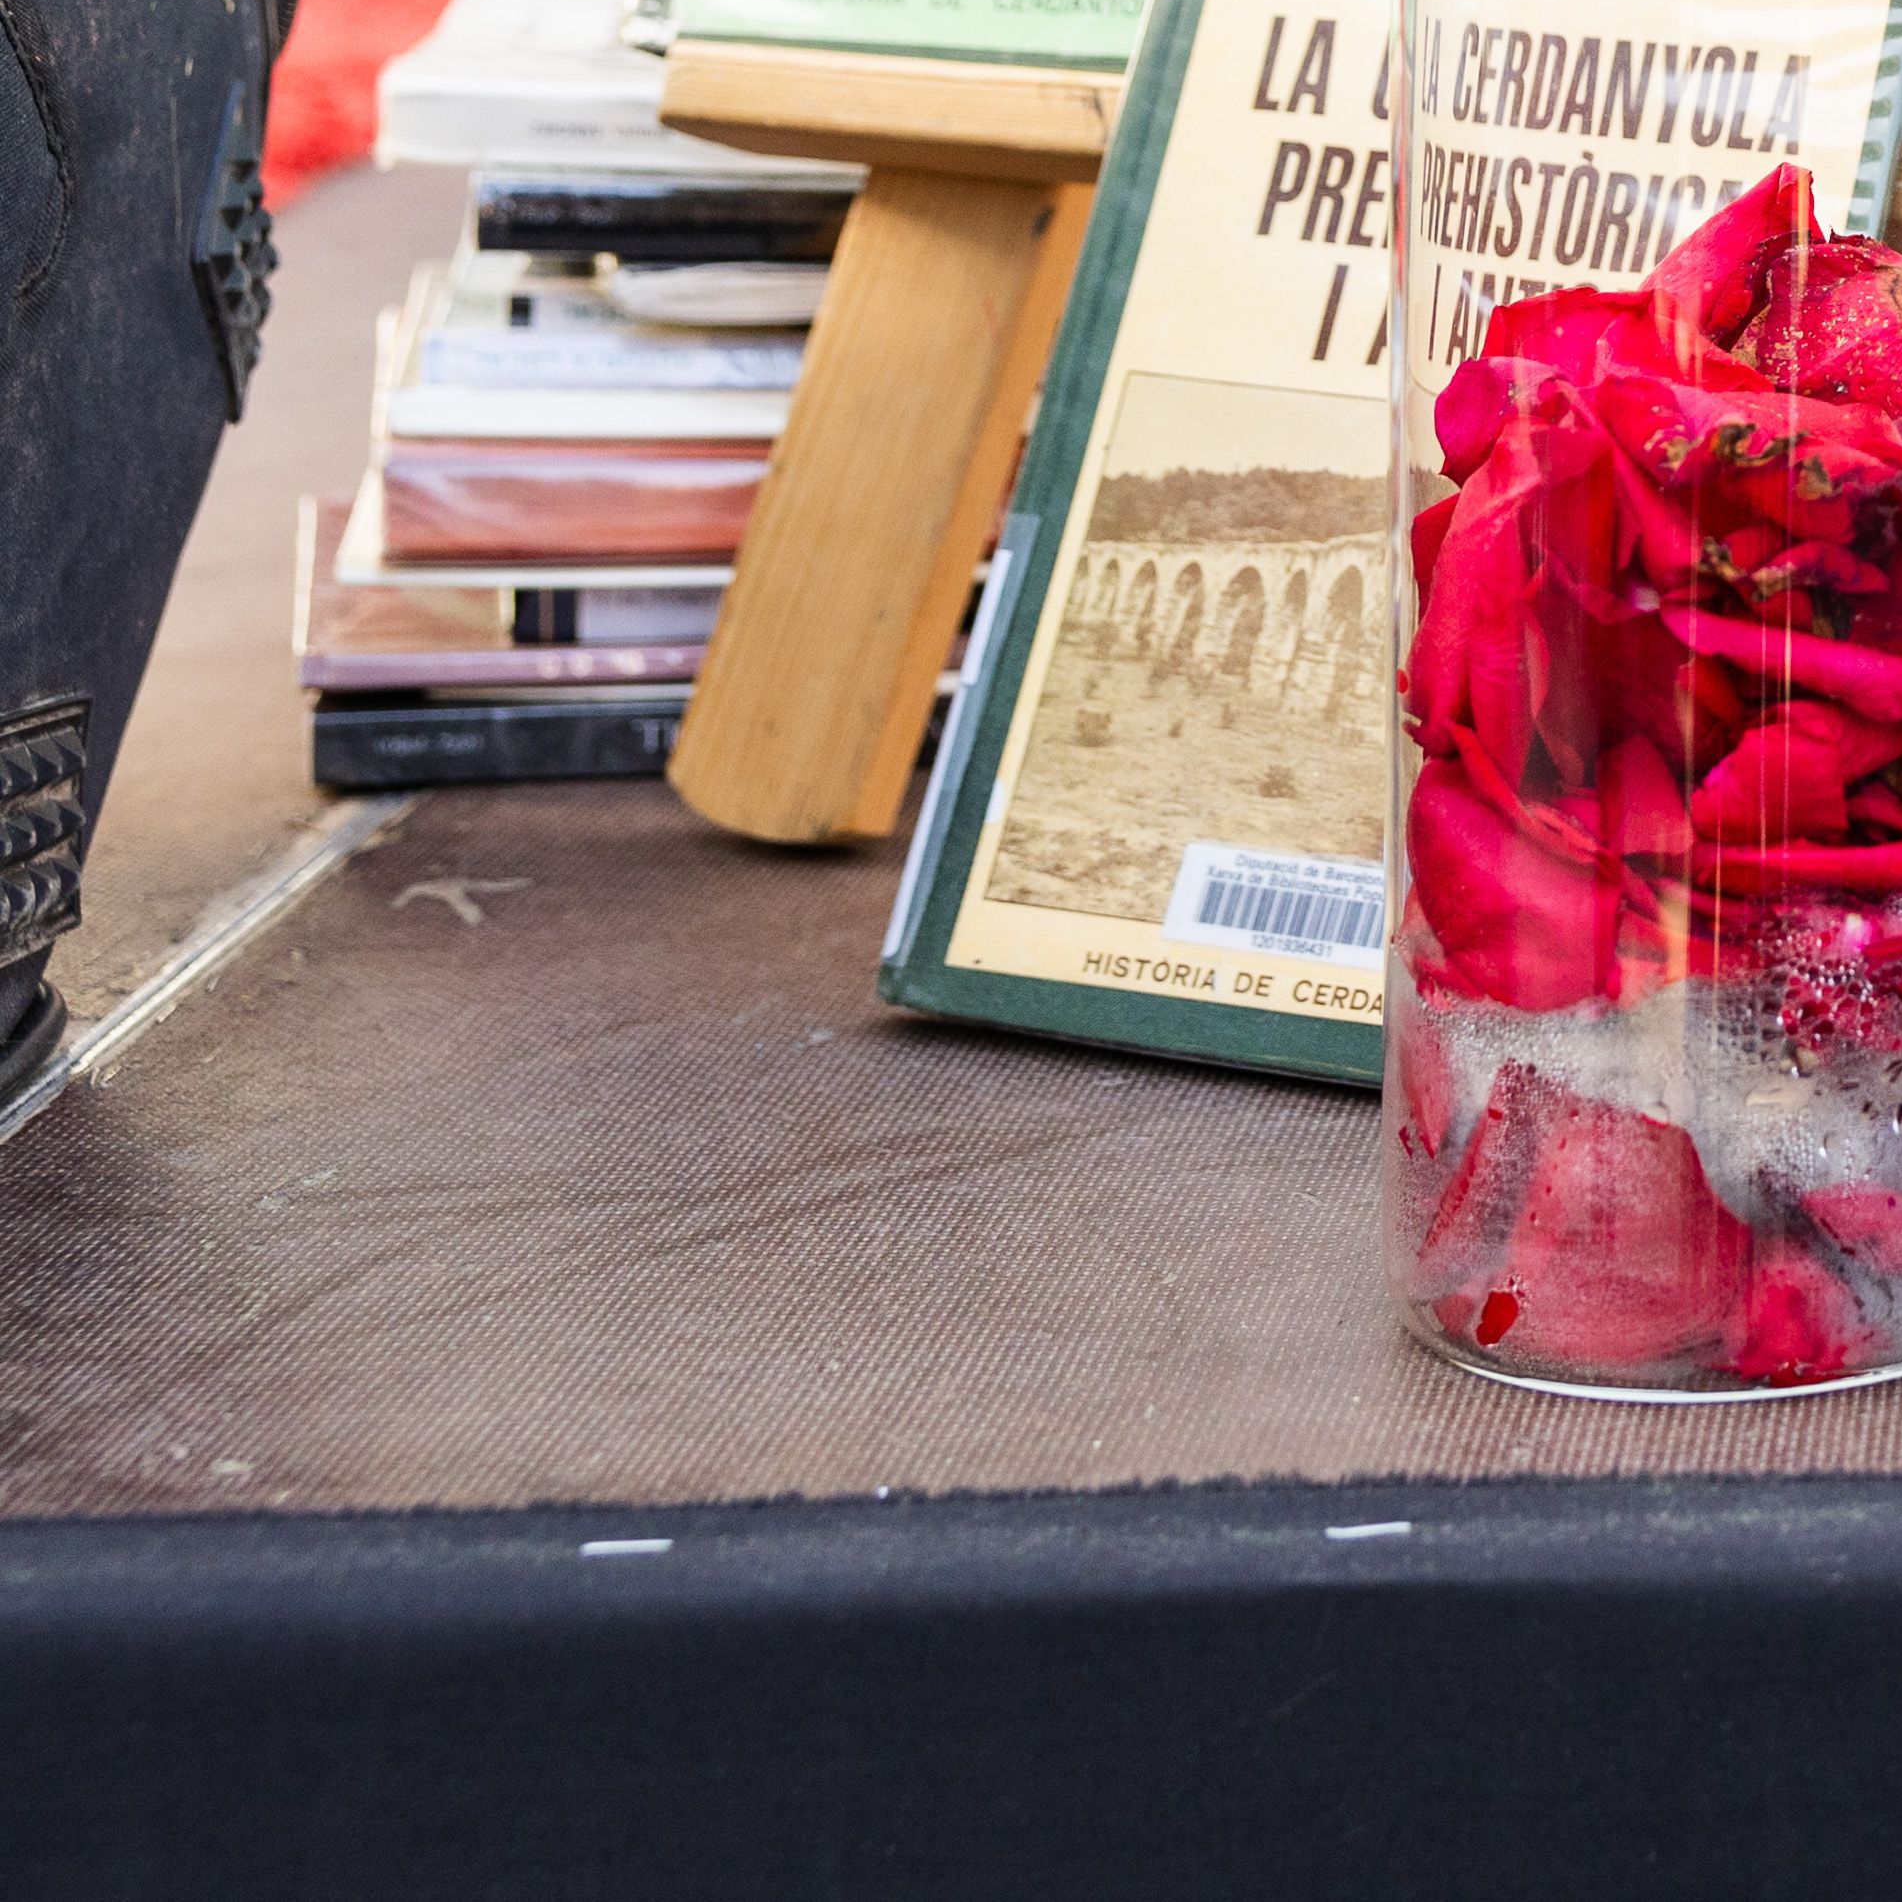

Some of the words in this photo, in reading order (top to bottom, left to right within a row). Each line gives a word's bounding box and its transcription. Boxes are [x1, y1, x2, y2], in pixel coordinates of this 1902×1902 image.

[1452, 21, 1811, 155] CERDANYOLA
[1248, 871, 1263, 884] de
[1304, 865, 1319, 878] de
[1233, 972, 1274, 998] DE
